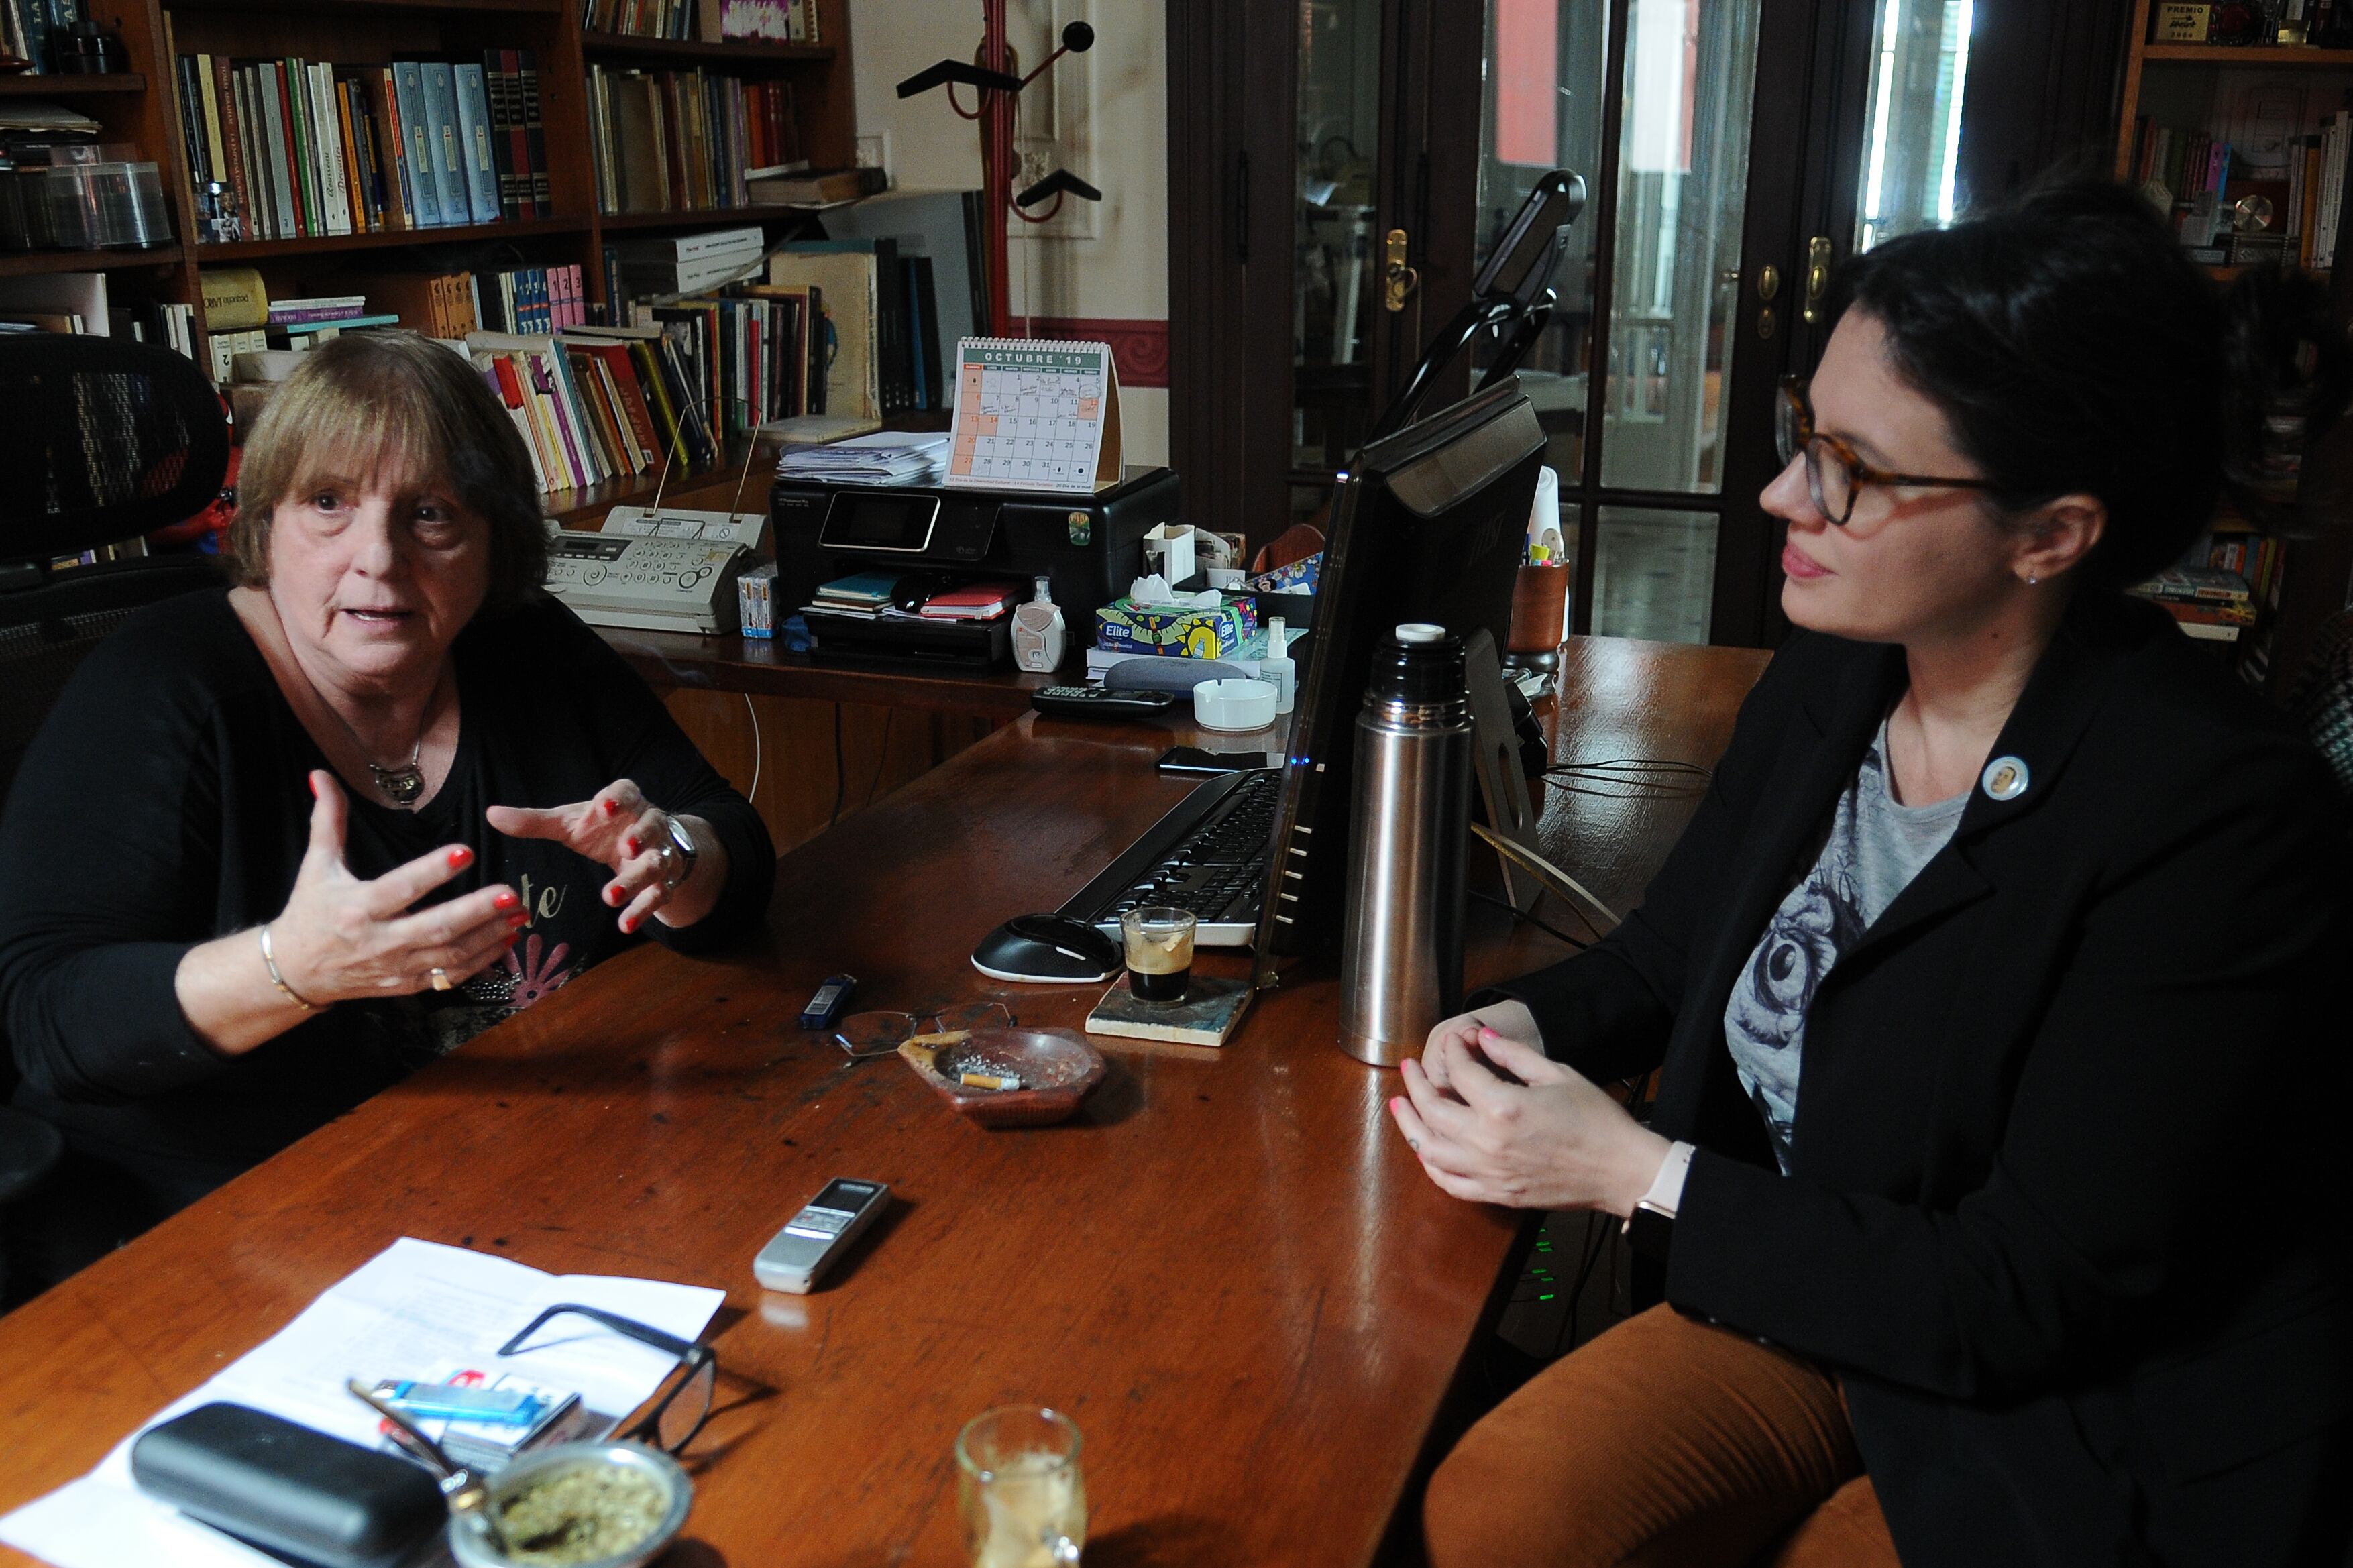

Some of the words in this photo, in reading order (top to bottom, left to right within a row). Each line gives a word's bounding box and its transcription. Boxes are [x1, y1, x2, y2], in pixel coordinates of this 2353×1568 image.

[2167, 6, 2203, 14] PREMIO
[325, 152, 334, 197] Rousseau
[337, 146, 346, 194] Descartes
[553, 281, 558, 293] 1
[563, 278, 569, 290] 2
[575, 277, 580, 289] 3
[222, 354, 229, 366] 2
[985, 352, 1053, 363] OCTUBRE
[1059, 355, 1082, 365] '19
[1105, 625, 1130, 637] Elite
[1221, 624, 1234, 638] Elite
